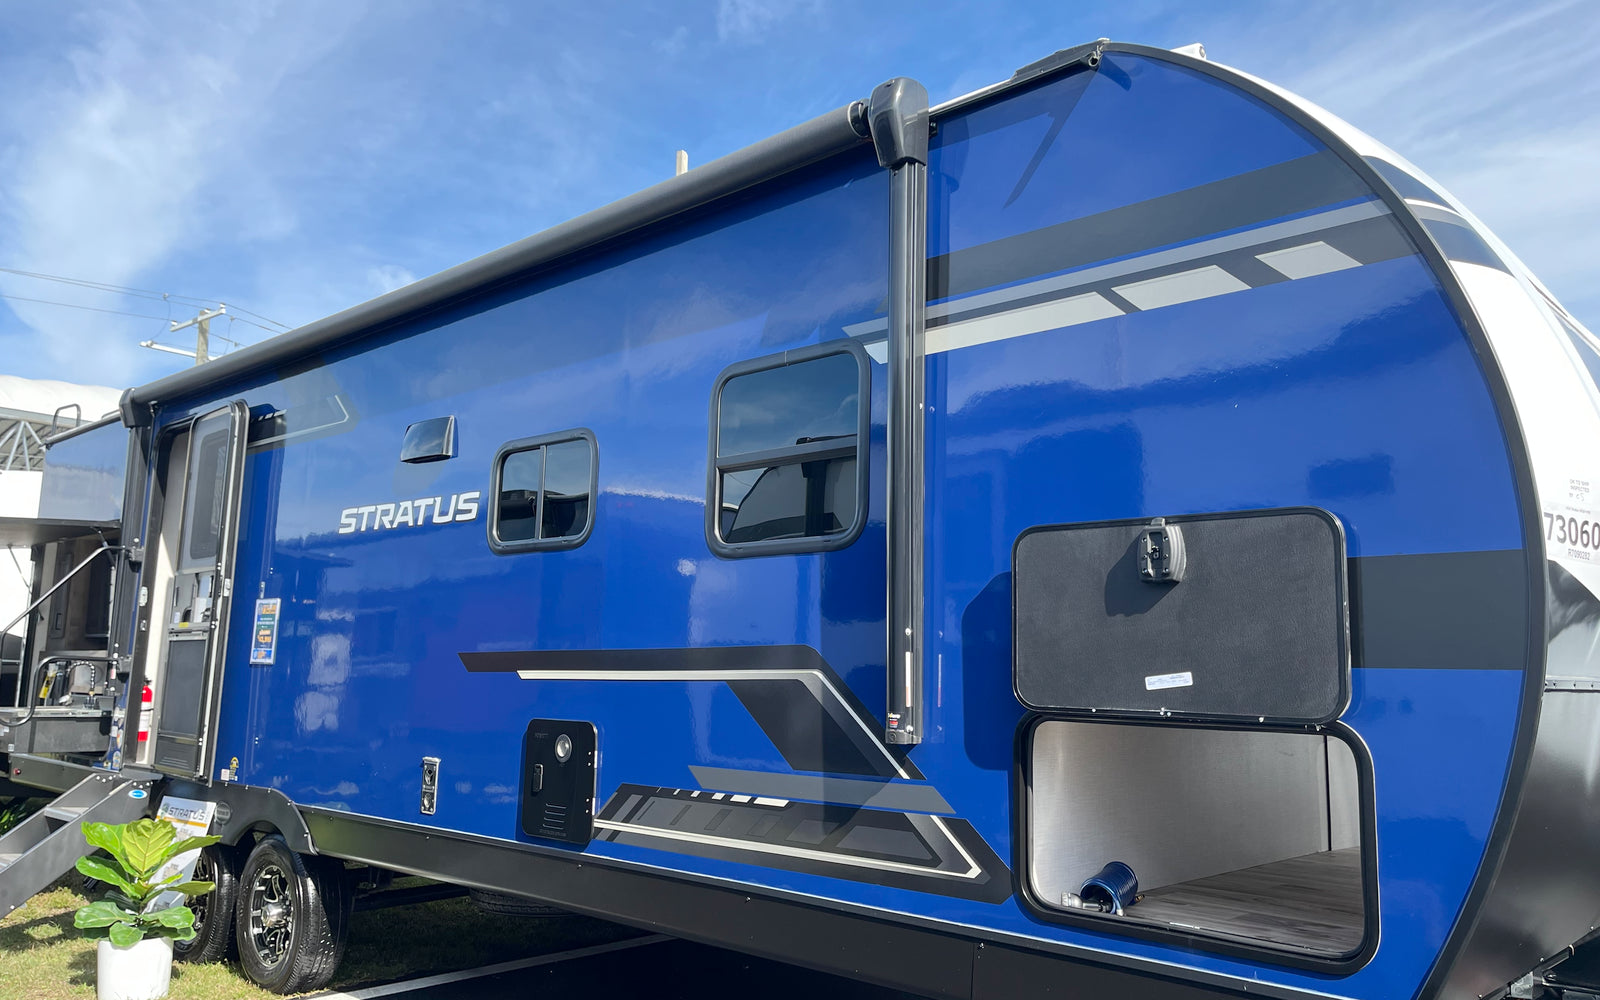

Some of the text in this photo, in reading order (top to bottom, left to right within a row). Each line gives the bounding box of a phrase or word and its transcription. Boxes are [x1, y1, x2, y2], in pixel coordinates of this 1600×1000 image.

[338, 491, 481, 534] STRATUS
[1543, 511, 1600, 551] 73060
[168, 806, 206, 821] STRATUS
